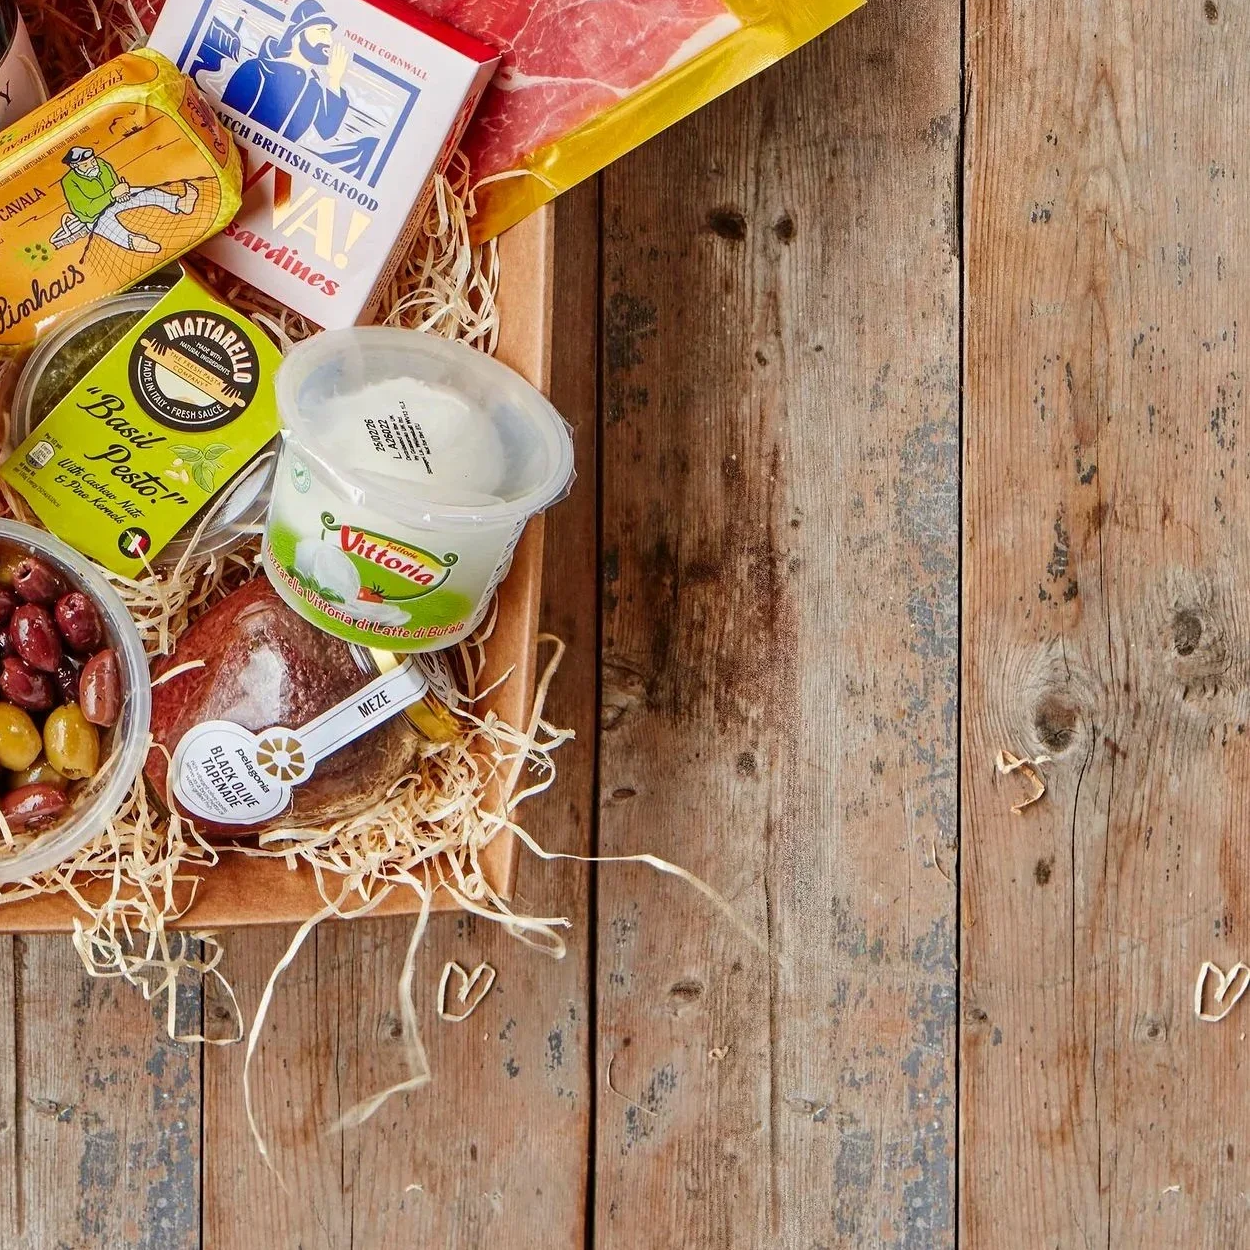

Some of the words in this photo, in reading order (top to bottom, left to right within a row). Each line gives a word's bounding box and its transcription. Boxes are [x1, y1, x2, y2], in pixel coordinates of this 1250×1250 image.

[344, 29, 377, 51] NORTH
[378, 46, 429, 80] CORNWALL
[252, 132, 310, 174] BRITISH
[312, 166, 380, 212] SEAFOOD
[223, 222, 340, 296] sardines
[163, 317, 252, 383] MATTARELLO
[180, 341, 200, 358] NATURAL
[200, 354, 230, 376] INGREDIENTS
[196, 342, 212, 353] MADE
[210, 350, 222, 361] WITH
[144, 360, 153, 382] MADE
[170, 352, 181, 361] THE
[182, 358, 202, 374] FRESH
[202, 370, 221, 386] PASTA
[146, 382, 155, 392] IN
[150, 390, 168, 408] ITALY
[170, 406, 196, 420] FRESH
[198, 404, 224, 420] SAUCE
[364, 418, 386, 452] 25/02/26
[378, 420, 398, 450] A26022
[393, 452, 402, 460] L
[54, 474, 64, 484] &
[62, 479, 90, 499] Pine
[88, 497, 124, 525] Kernels
[58, 458, 85, 477] With
[82, 473, 117, 500] Cashew
[117, 500, 146, 519] Nuts
[341, 525, 436, 586] Vittoria
[386, 542, 418, 560] Fattorie
[306, 590, 353, 626] Vittoria
[357, 619, 370, 631] di
[372, 622, 410, 638] Latte
[414, 628, 424, 639] di
[428, 622, 464, 638] Bufala
[358, 690, 391, 718] MEZE
[202, 757, 242, 808] TAPENADE
[210, 745, 238, 782] BLACK
[232, 782, 260, 808] OLIVE
[235, 748, 270, 794] pelagonia
